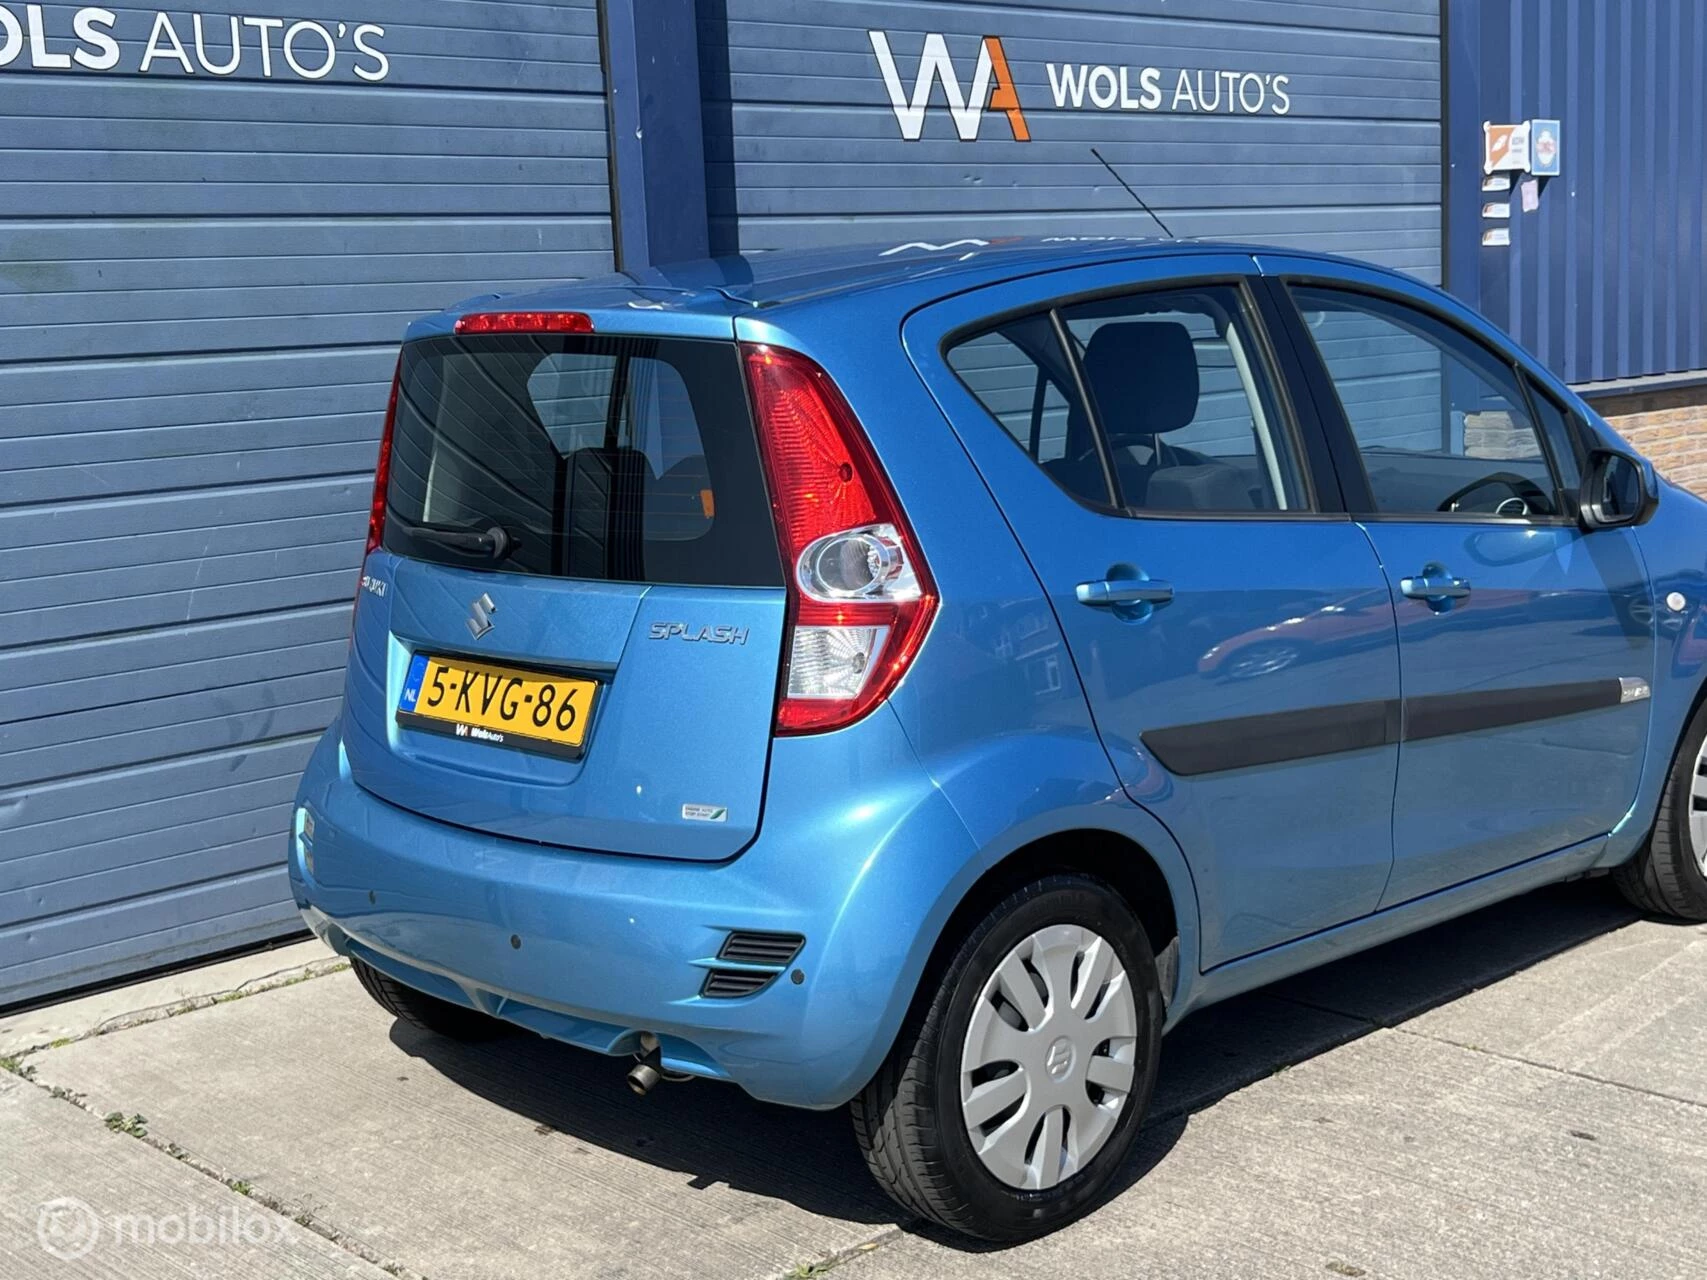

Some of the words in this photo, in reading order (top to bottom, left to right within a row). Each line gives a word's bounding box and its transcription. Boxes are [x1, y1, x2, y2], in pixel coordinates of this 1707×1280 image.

[138, 11, 390, 81] AUTO'S
[868, 30, 1031, 141] WA
[1046, 62, 1161, 112] WOLS
[1171, 68, 1290, 115] AUTO'S
[648, 621, 750, 645] SPLASH
[404, 688, 416, 702] NL
[427, 666, 578, 731] 5-KVG-86
